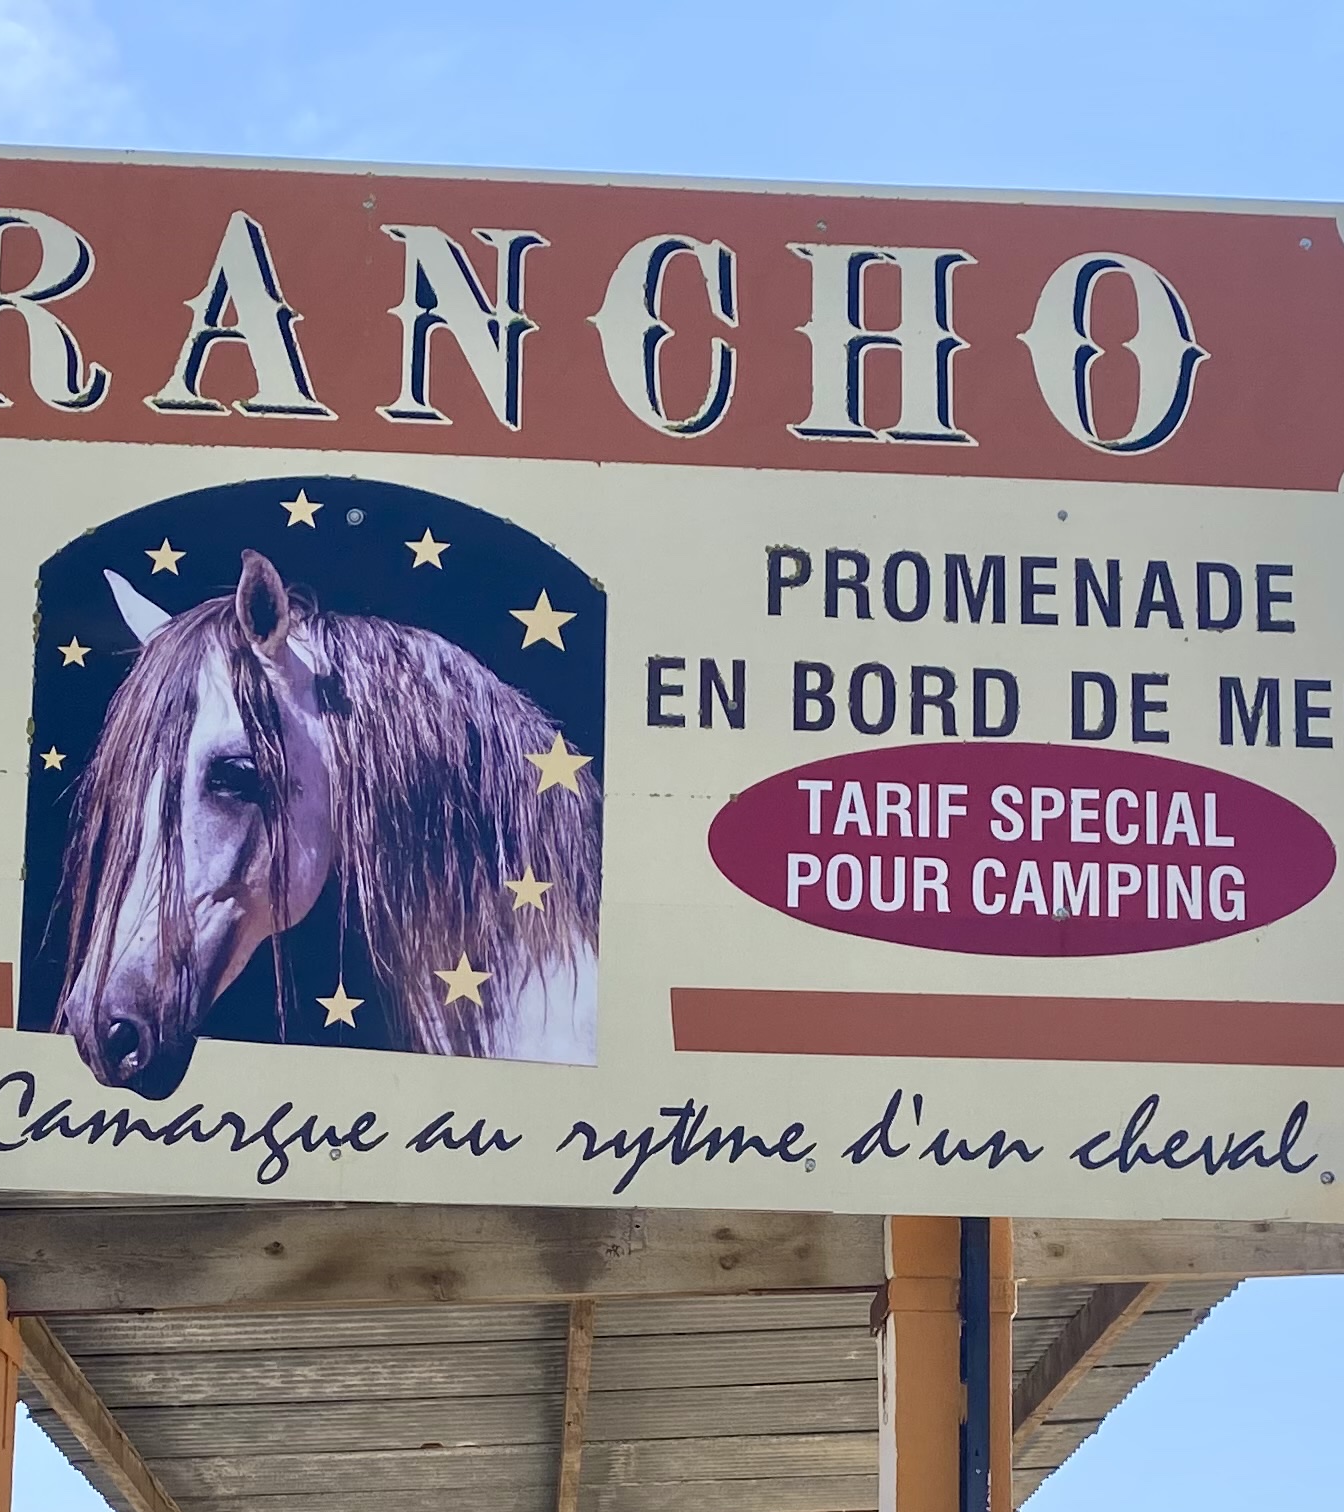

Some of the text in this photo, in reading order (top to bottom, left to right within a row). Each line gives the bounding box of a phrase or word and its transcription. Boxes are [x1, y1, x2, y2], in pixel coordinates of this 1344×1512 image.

[766, 546, 1296, 633] PROMENADE
[646, 656, 747, 730] EN
[792, 661, 1021, 739] BORD
[1070, 671, 1171, 743] DE
[797, 780, 1235, 848] TARIF SPECIAL
[787, 854, 1247, 921] POUR CAMPING
[407, 1107, 521, 1156] au
[841, 1089, 1044, 1169] d'un
